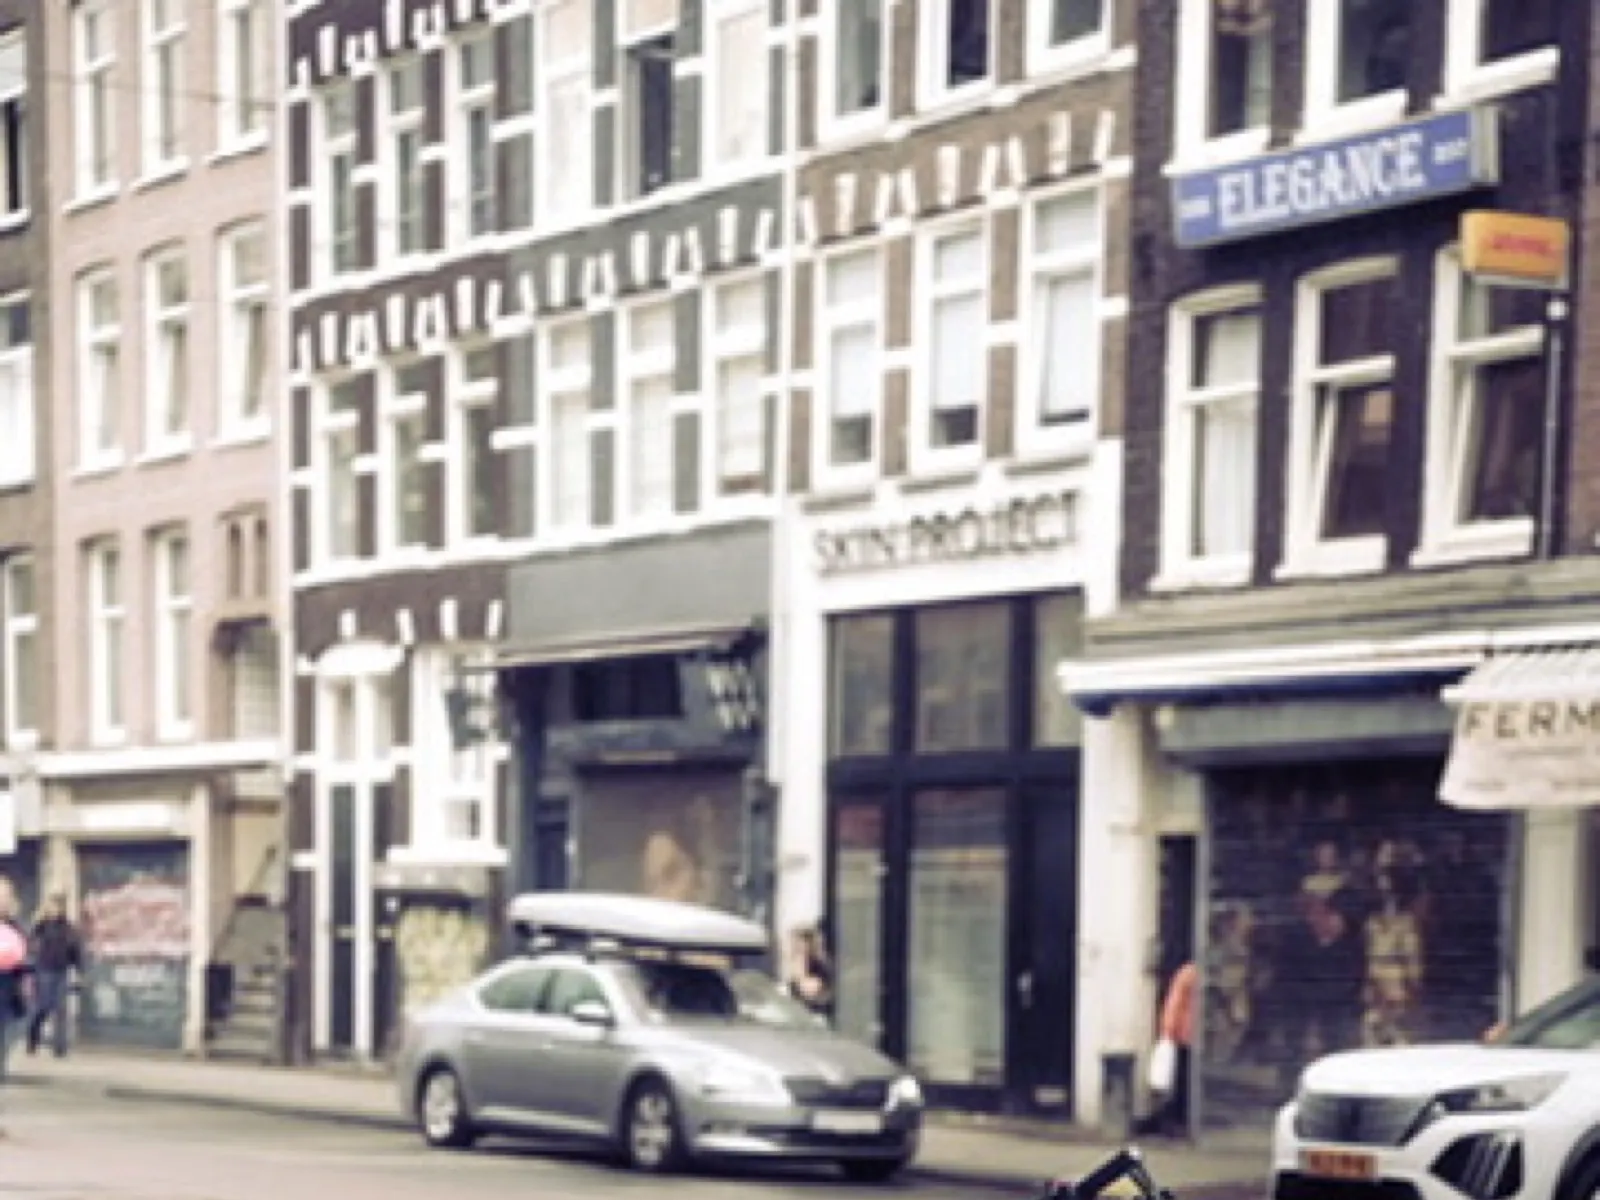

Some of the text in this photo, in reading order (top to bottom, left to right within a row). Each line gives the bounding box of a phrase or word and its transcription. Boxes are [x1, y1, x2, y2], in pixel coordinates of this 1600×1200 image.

[1217, 131, 1426, 228] ELEGANCE
[815, 489, 1079, 577] SKIN PROJECT
[1463, 700, 1600, 738] FERM
